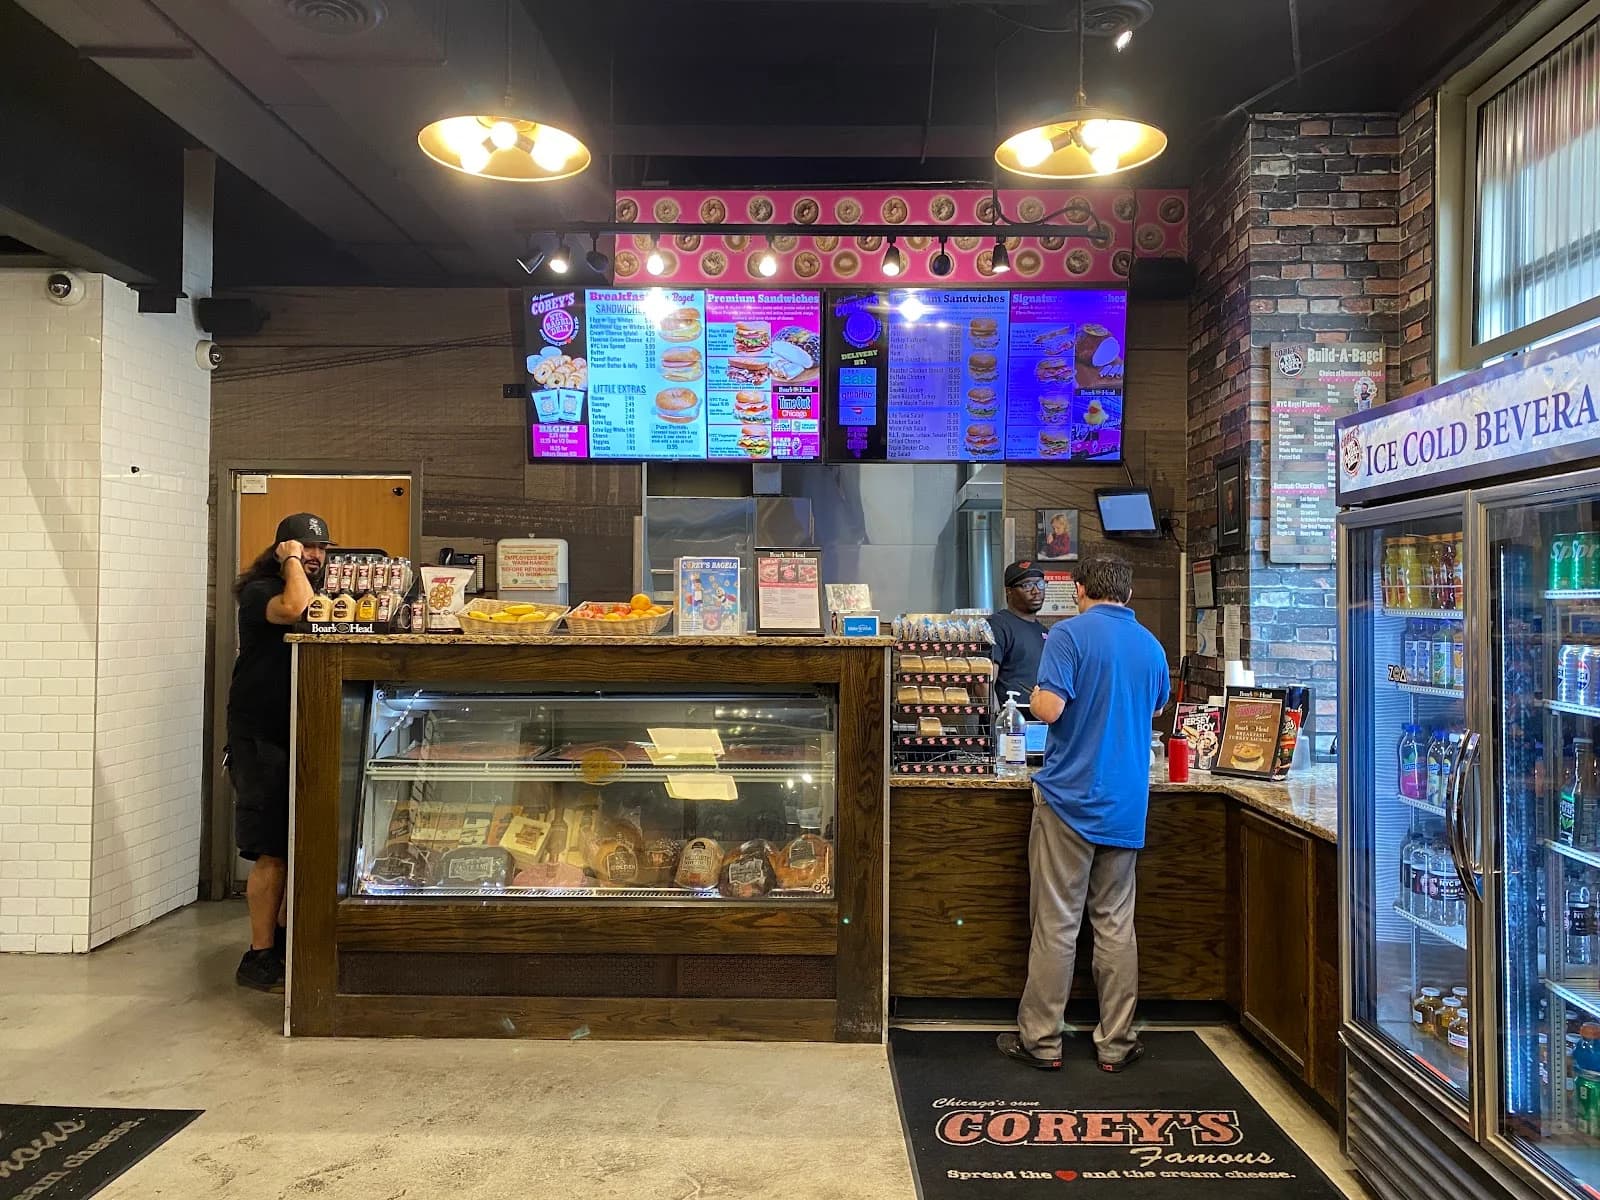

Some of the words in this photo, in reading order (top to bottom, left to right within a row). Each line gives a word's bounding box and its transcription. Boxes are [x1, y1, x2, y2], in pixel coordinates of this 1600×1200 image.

[589, 292, 648, 301] Breakfas
[707, 294, 756, 303] Premium
[758, 294, 819, 304] Sandwiches
[943, 294, 1005, 303] Sandwiches
[531, 292, 575, 315] COREY'S
[596, 304, 646, 315] SANDWICH
[841, 350, 878, 360] DELIVERY
[1307, 348, 1383, 365] Build-A-Bagel
[593, 384, 617, 394] LITTLE
[618, 384, 647, 393] EXTRAS
[781, 410, 808, 418] Chicago
[1366, 440, 1398, 476] ICE
[1403, 421, 1468, 467] COLD
[1474, 383, 1599, 451] BEVERA
[682, 561, 711, 569] COREY'S
[711, 561, 738, 569] BAGELS
[311, 624, 337, 633] Boar's
[350, 624, 374, 633] Head
[1183, 715, 1210, 726] JERSEY
[1196, 722, 1215, 732] BOY
[1255, 725, 1270, 733] Head
[931, 1097, 1007, 1109] Chicago's
[1010, 1100, 1041, 1108] own
[935, 1109, 1245, 1147] COREY'S
[63, 1116, 147, 1169] cheese.
[1129, 1146, 1275, 1168] Famous
[946, 1168, 1017, 1181] Spread
[1020, 1169, 1054, 1180] the
[1082, 1169, 1119, 1180] and
[1121, 1169, 1156, 1180] the
[1158, 1170, 1223, 1180] cream
[1224, 1170, 1297, 1180] cheese.
